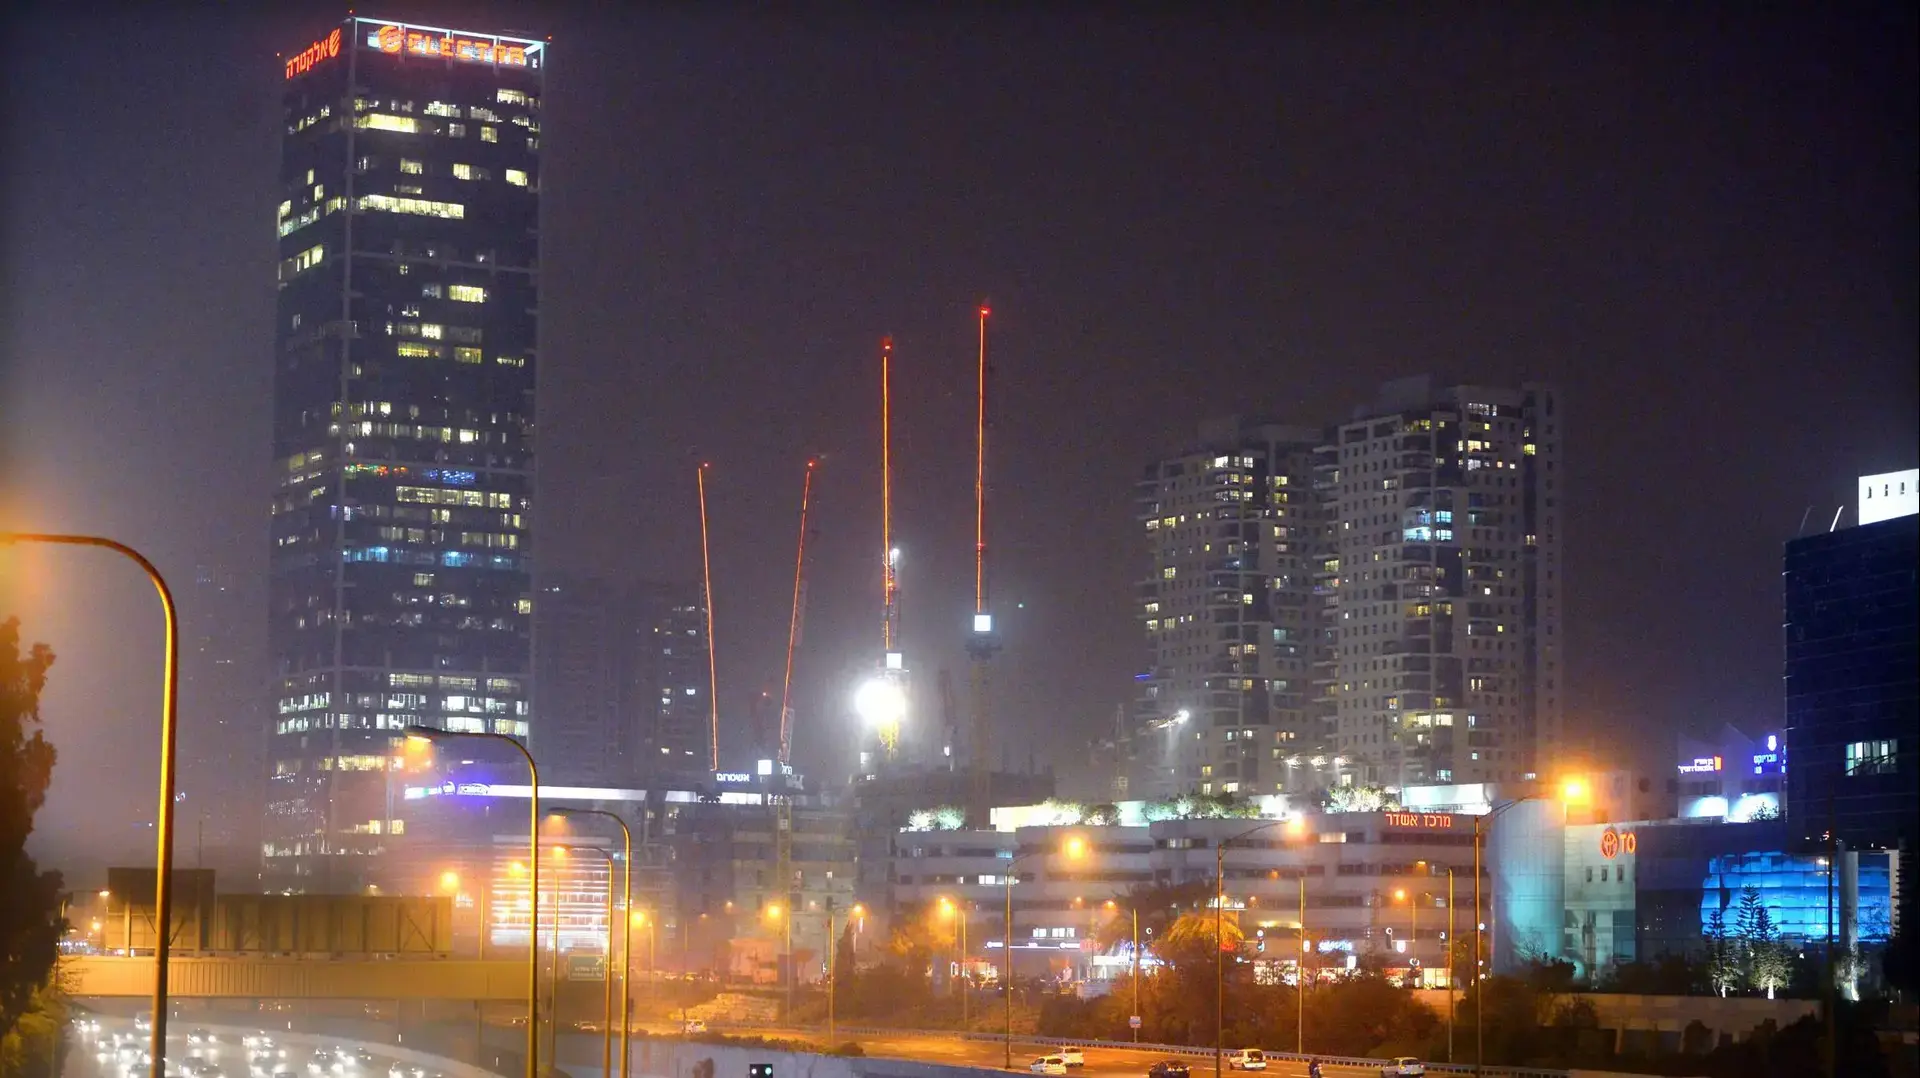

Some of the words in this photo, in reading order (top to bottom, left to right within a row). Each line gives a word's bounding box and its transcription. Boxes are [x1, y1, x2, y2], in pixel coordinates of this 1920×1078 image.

[286, 40, 328, 79] אלקטרה
[408, 33, 526, 66] ELECTRA
[1385, 813, 1418, 827] אשדר
[1424, 814, 1451, 828] מרכז
[1620, 831, 1636, 854] TO
